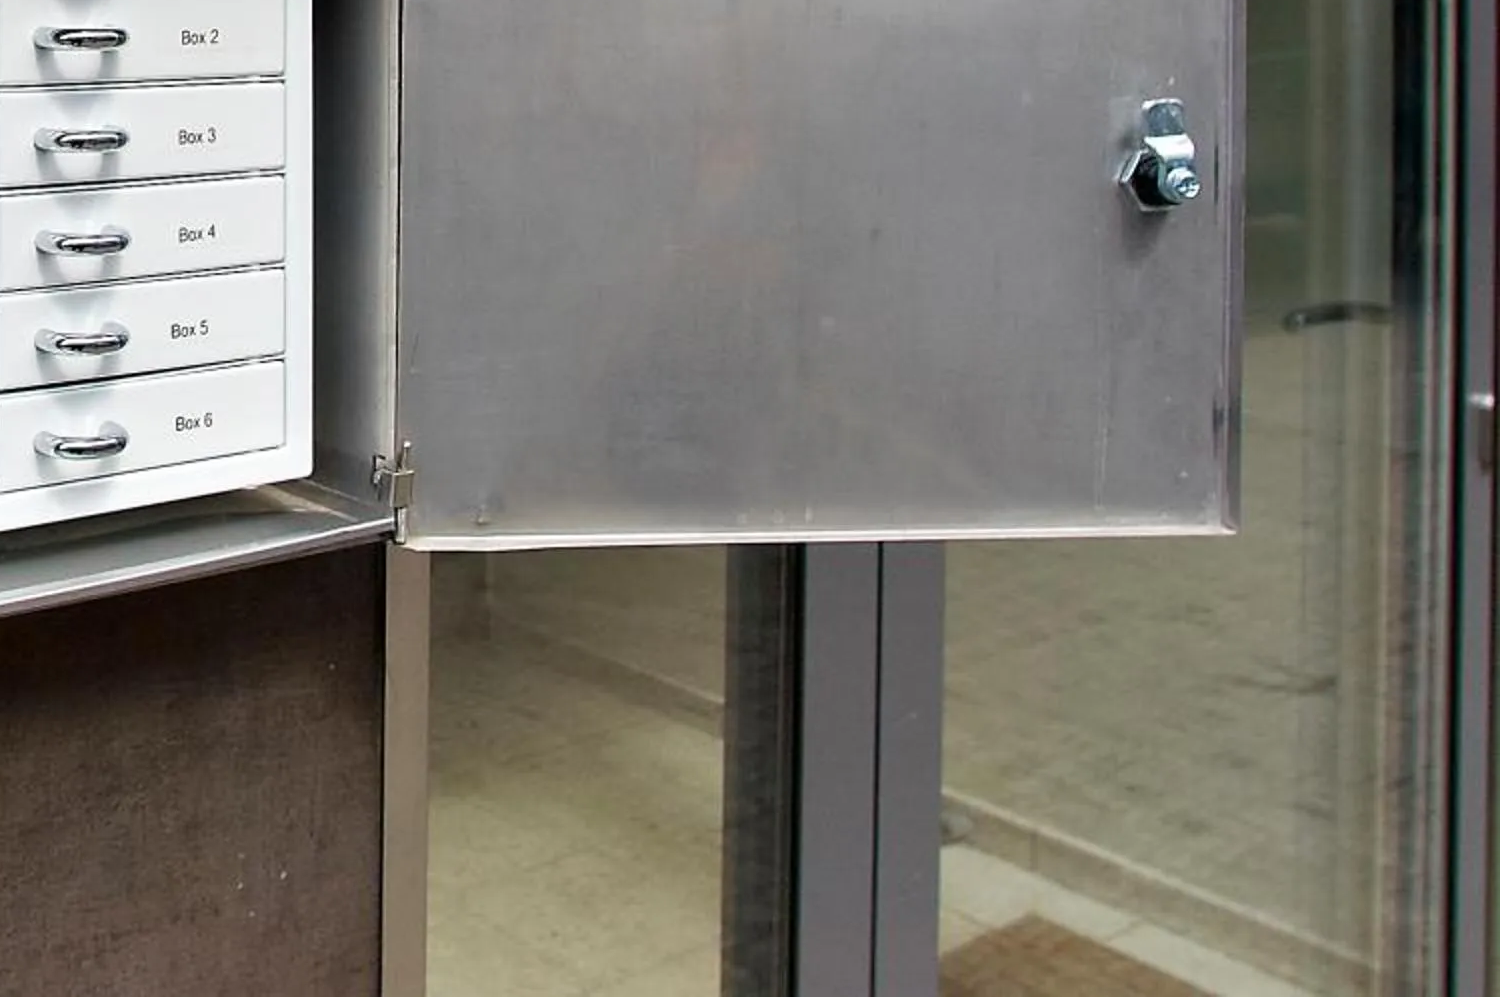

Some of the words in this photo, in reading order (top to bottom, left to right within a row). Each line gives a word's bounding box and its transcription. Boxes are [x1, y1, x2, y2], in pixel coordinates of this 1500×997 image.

[181, 29, 207, 46] Box
[209, 28, 220, 44] 2
[178, 128, 204, 146] Box
[207, 126, 217, 144] 3
[178, 226, 203, 244] Box
[206, 223, 217, 239] 4
[170, 321, 197, 340] Box
[199, 319, 209, 336] 5
[175, 415, 201, 432] Box
[203, 412, 213, 428] 6
